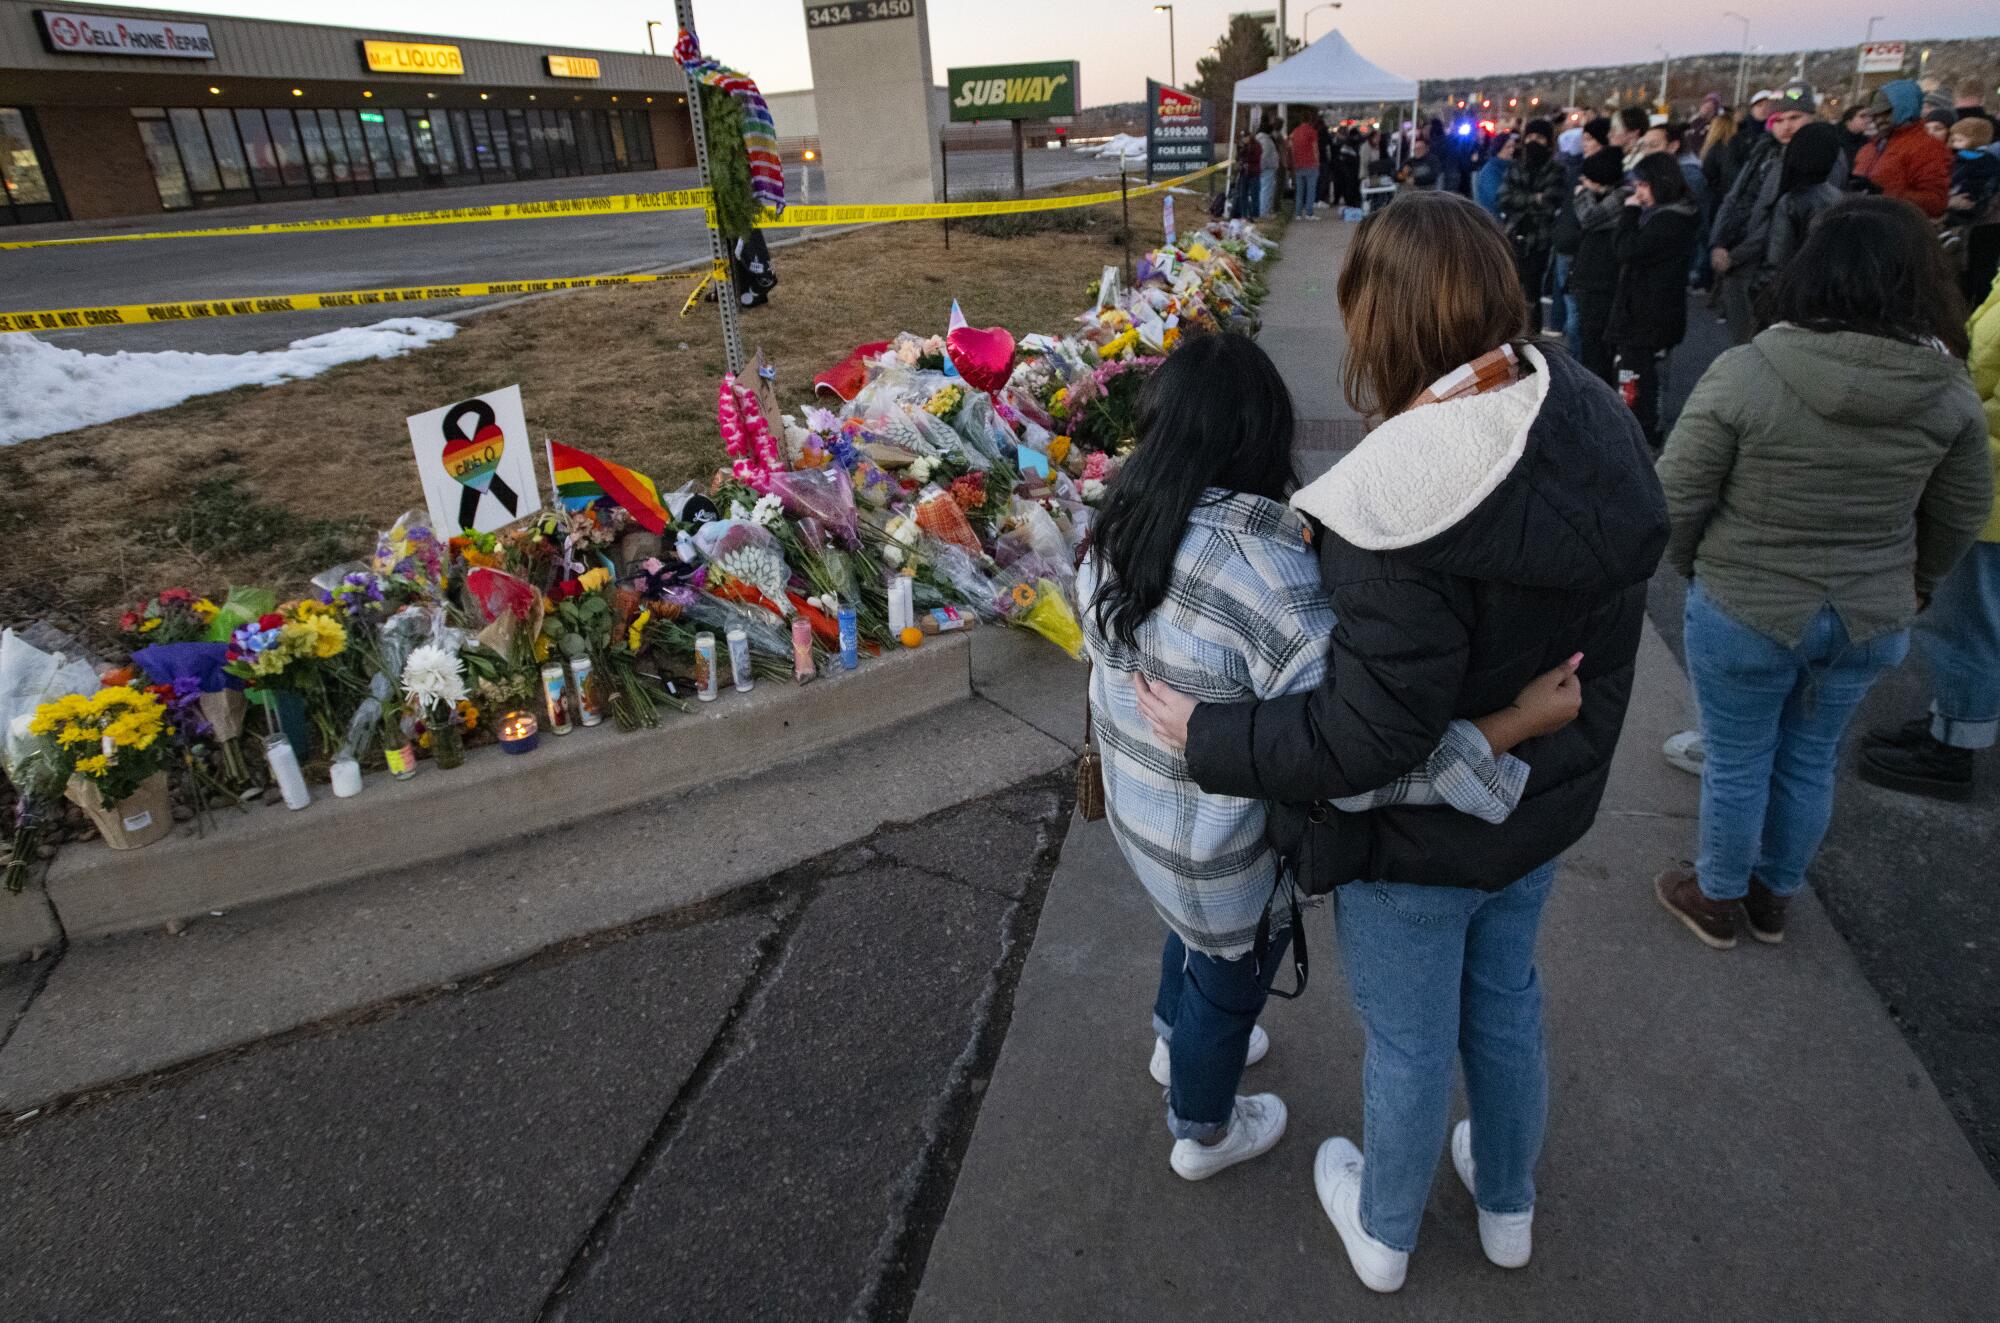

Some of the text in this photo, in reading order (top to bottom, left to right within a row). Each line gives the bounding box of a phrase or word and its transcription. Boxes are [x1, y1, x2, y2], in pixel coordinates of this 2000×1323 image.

[808, 6, 851, 26] 3434
[867, 0, 911, 18] 3450
[80, 20, 213, 51] CELL PHONE REPAIR
[395, 47, 461, 69] LIQUOR
[953, 73, 1068, 108] SUBWAY
[1158, 145, 1202, 156] FOR LEASE
[635, 193, 661, 208] POLICE
[661, 191, 678, 206] LINE
[678, 190, 689, 205] DO
[690, 190, 705, 205] NOT
[146, 297, 295, 321] POLICE LINE DO NOT CROSS
[318, 295, 354, 308] POLICE
[357, 293, 380, 305] LINE
[383, 291, 399, 303] DO
[401, 289, 423, 302] NOT
[12, 314, 40, 330] LINE
[38, 313, 58, 328] DO
[57, 311, 83, 326] NOT
[83, 309, 124, 325] CROSS
